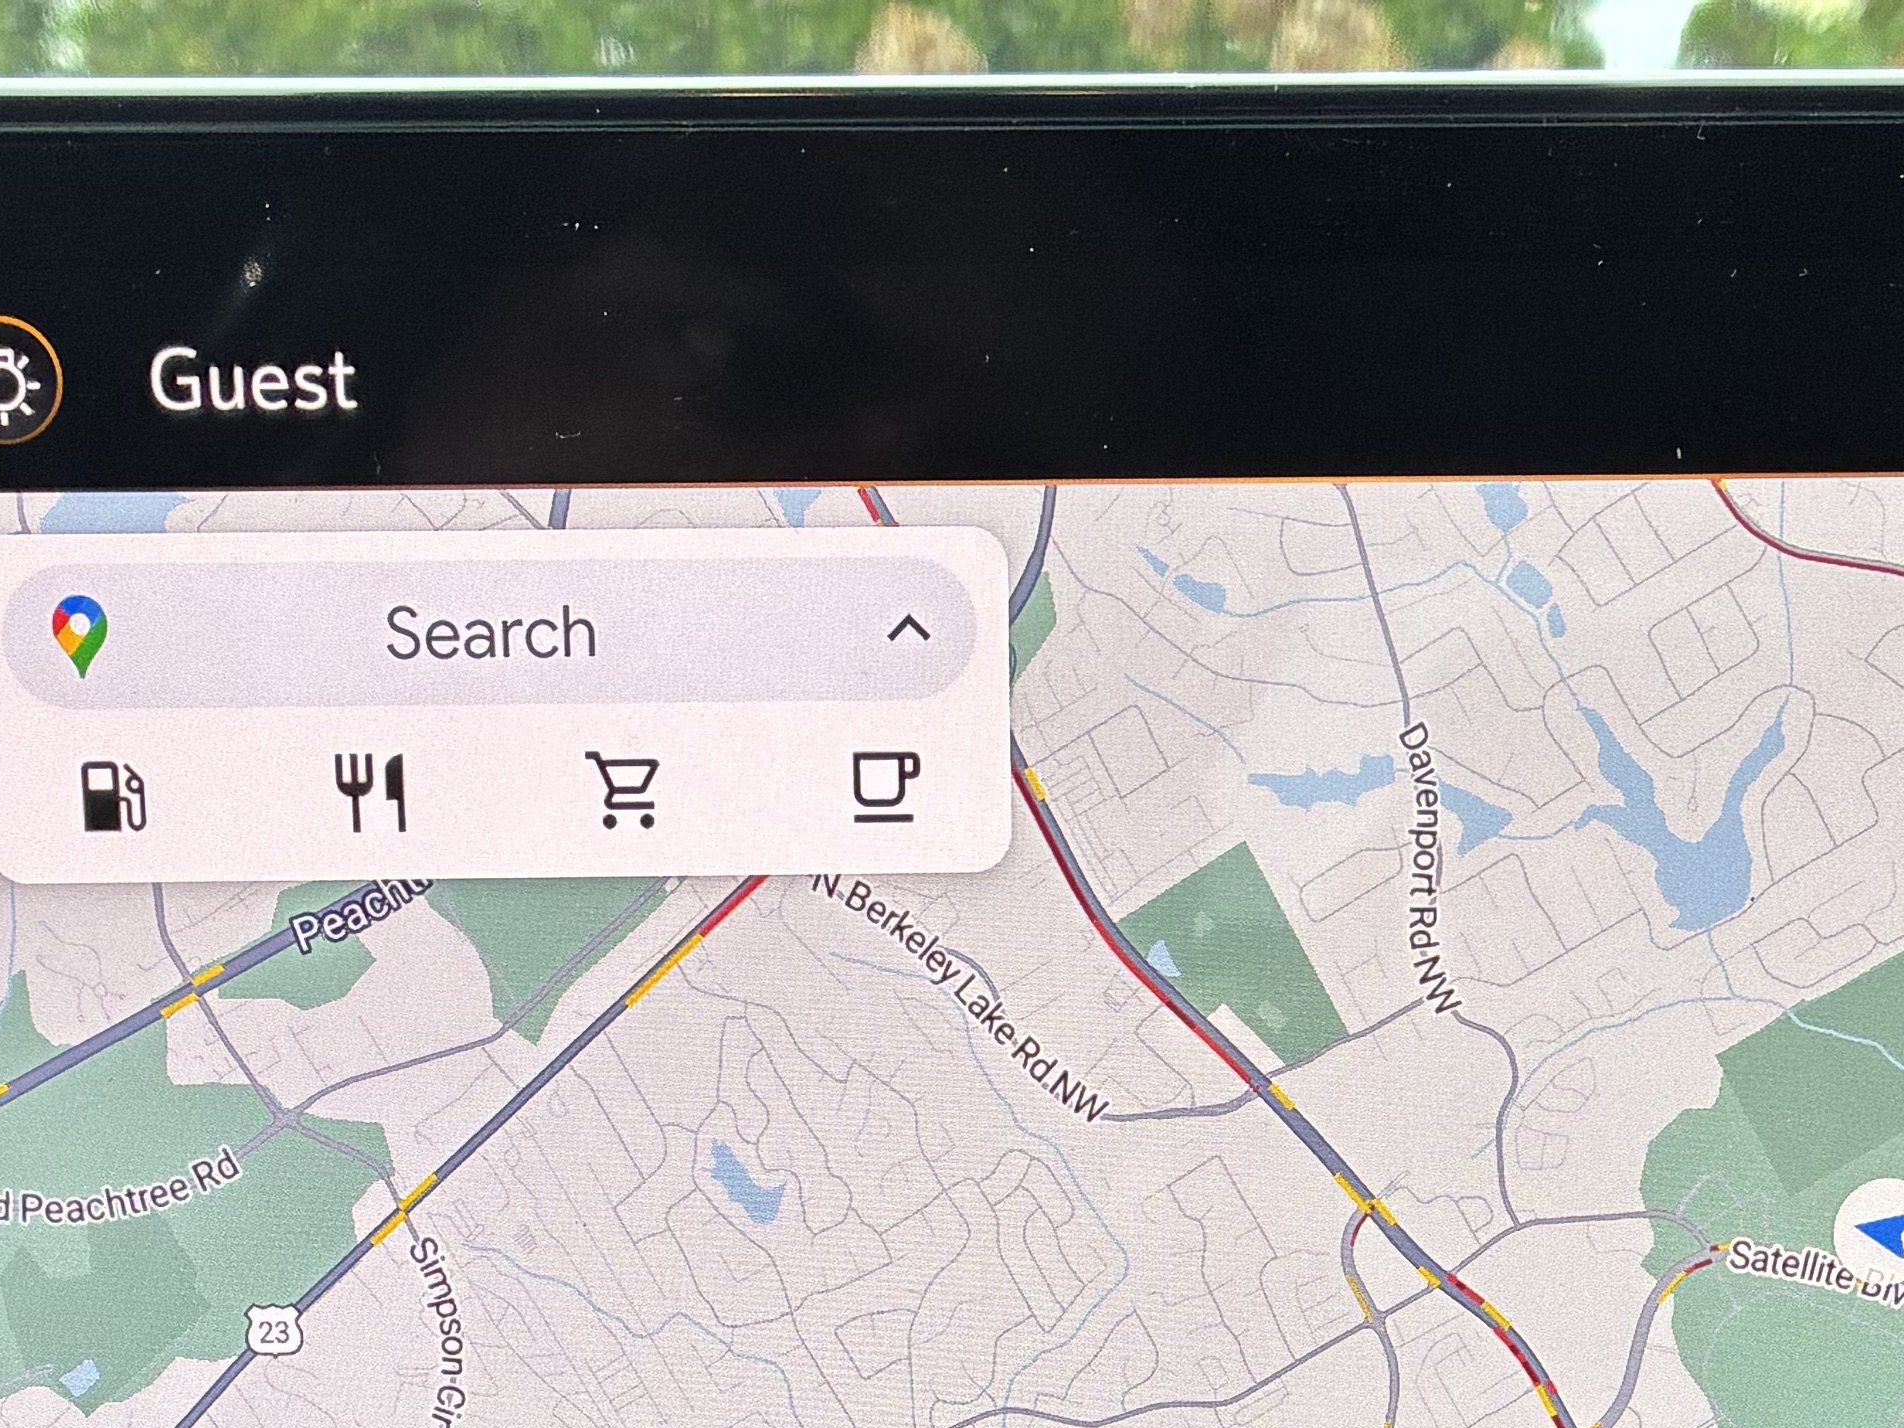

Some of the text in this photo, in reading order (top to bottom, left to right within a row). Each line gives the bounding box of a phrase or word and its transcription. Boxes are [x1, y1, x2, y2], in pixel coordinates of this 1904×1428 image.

[150, 347, 359, 413] Guest
[386, 604, 597, 660] Search
[1399, 722, 1462, 1014] Davenport Rd NW
[845, 881, 960, 985] Berkeley
[954, 974, 1015, 1045] Lake
[1011, 1036, 1058, 1083] Rd
[1049, 1070, 1110, 1123] NW
[21, 1181, 191, 1224] Peachtree
[193, 1148, 241, 1195] Rd
[1730, 1240, 1854, 1289] Satellite
[258, 1321, 291, 1345] 23
[410, 1237, 466, 1428] Simpson Cir
